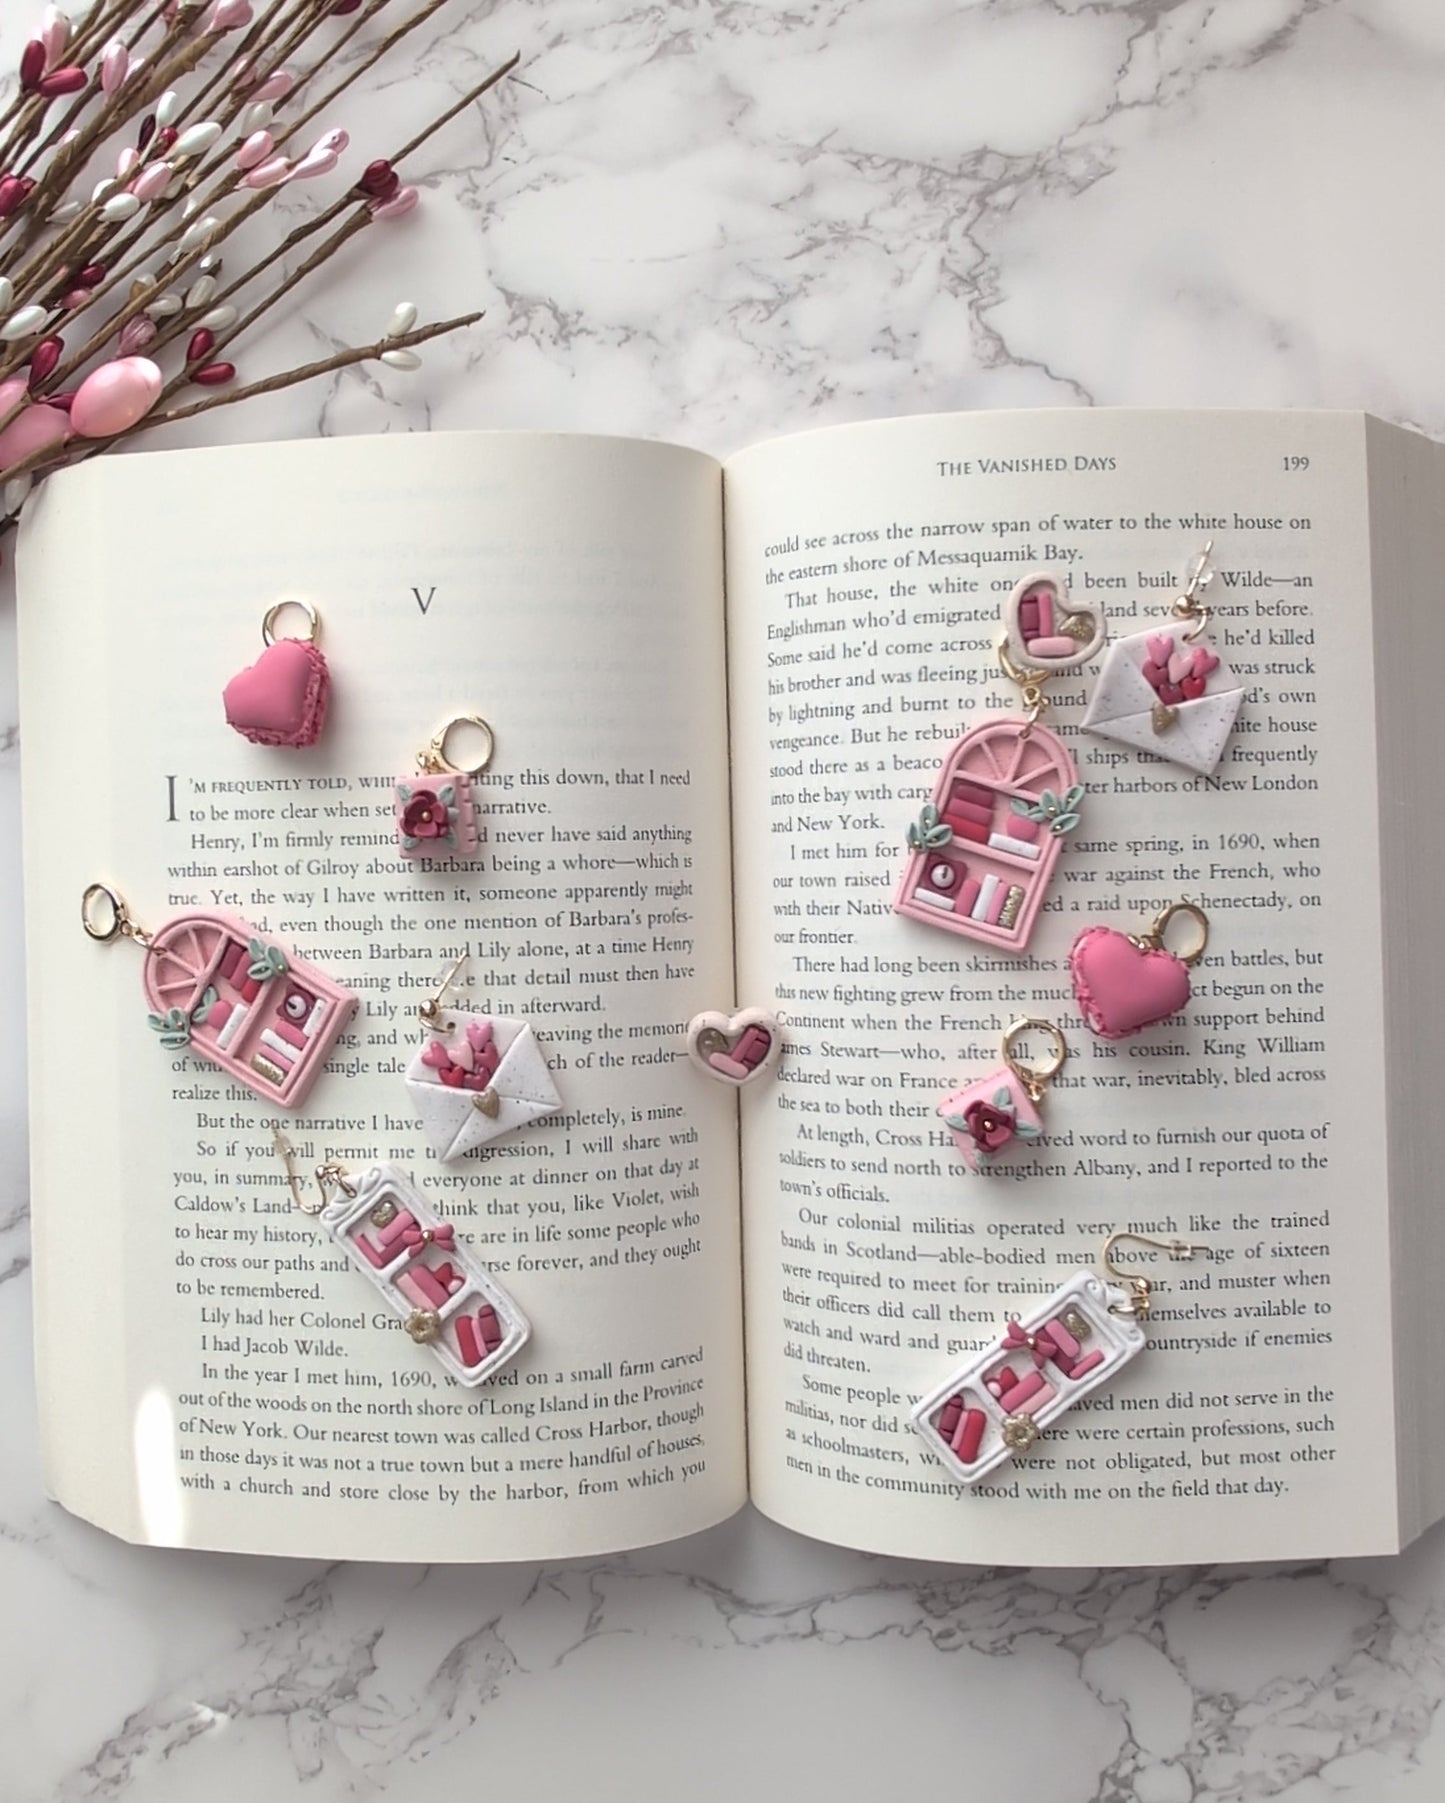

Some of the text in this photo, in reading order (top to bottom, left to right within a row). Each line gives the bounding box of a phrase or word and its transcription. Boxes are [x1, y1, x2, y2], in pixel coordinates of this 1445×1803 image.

[936, 455, 1117, 477] THE VANISHED DAYS
[1283, 456, 1310, 472] 199
[764, 511, 1312, 558] could see across the narrow span of water to the white house on
[765, 543, 1084, 586] the eastern shore of Messaquamik Bay.
[410, 586, 437, 616] V
[770, 812, 886, 833] and New York.
[790, 840, 900, 861] I met him for
[1073, 831, 1320, 857] same spring, in 1690, when
[167, 860, 218, 878] within
[222, 859, 279, 877] earshot
[284, 858, 304, 876] of
[306, 857, 360, 880] Gilroy
[365, 856, 414, 875] about
[420, 855, 486, 873] Barbara
[492, 854, 542, 876] being
[546, 859, 556, 871] a
[683, 856, 693, 868] is
[209, 889, 244, 907] Yet,
[250, 887, 277, 905] the
[282, 892, 315, 909] way
[323, 887, 329, 904] I
[336, 886, 376, 904] have
[383, 886, 445, 903] written
[453, 885, 471, 904] it,
[479, 888, 558, 901] someone
[564, 880, 649, 904] apparently
[654, 879, 693, 901] might
[779, 1149, 1329, 1182] soldiers to send north to strengthen Albany, and I reported to the
[825, 1182, 891, 1204] officials.
[798, 1207, 1331, 1241] Our colonial militias operated very much like the trained
[201, 1334, 349, 1358] I had Jacob Wilde.
[783, 1340, 871, 1374] did threaten.
[178, 1378, 704, 1419] out of the woods on the north shore of Long Island in the Province
[178, 1401, 704, 1445] of New York. Our nearest town was called Cross Harbor, though
[179, 1448, 195, 1461] in
[199, 1445, 240, 1464] those
[244, 1448, 279, 1471] days
[282, 1451, 295, 1468] it
[298, 1456, 329, 1470] was
[333, 1458, 362, 1471] not
[366, 1460, 376, 1472] a
[380, 1459, 415, 1473] true
[419, 1460, 465, 1473] town
[470, 1455, 500, 1473] but
[504, 1460, 514, 1472] a
[519, 1457, 564, 1472] mere
[569, 1444, 631, 1469] handful
[636, 1439, 656, 1460] of
[179, 1460, 706, 1507] with a church and store close by the harbor, from which you
[786, 1454, 1289, 1502] men in the community stood with me on the field that day.
